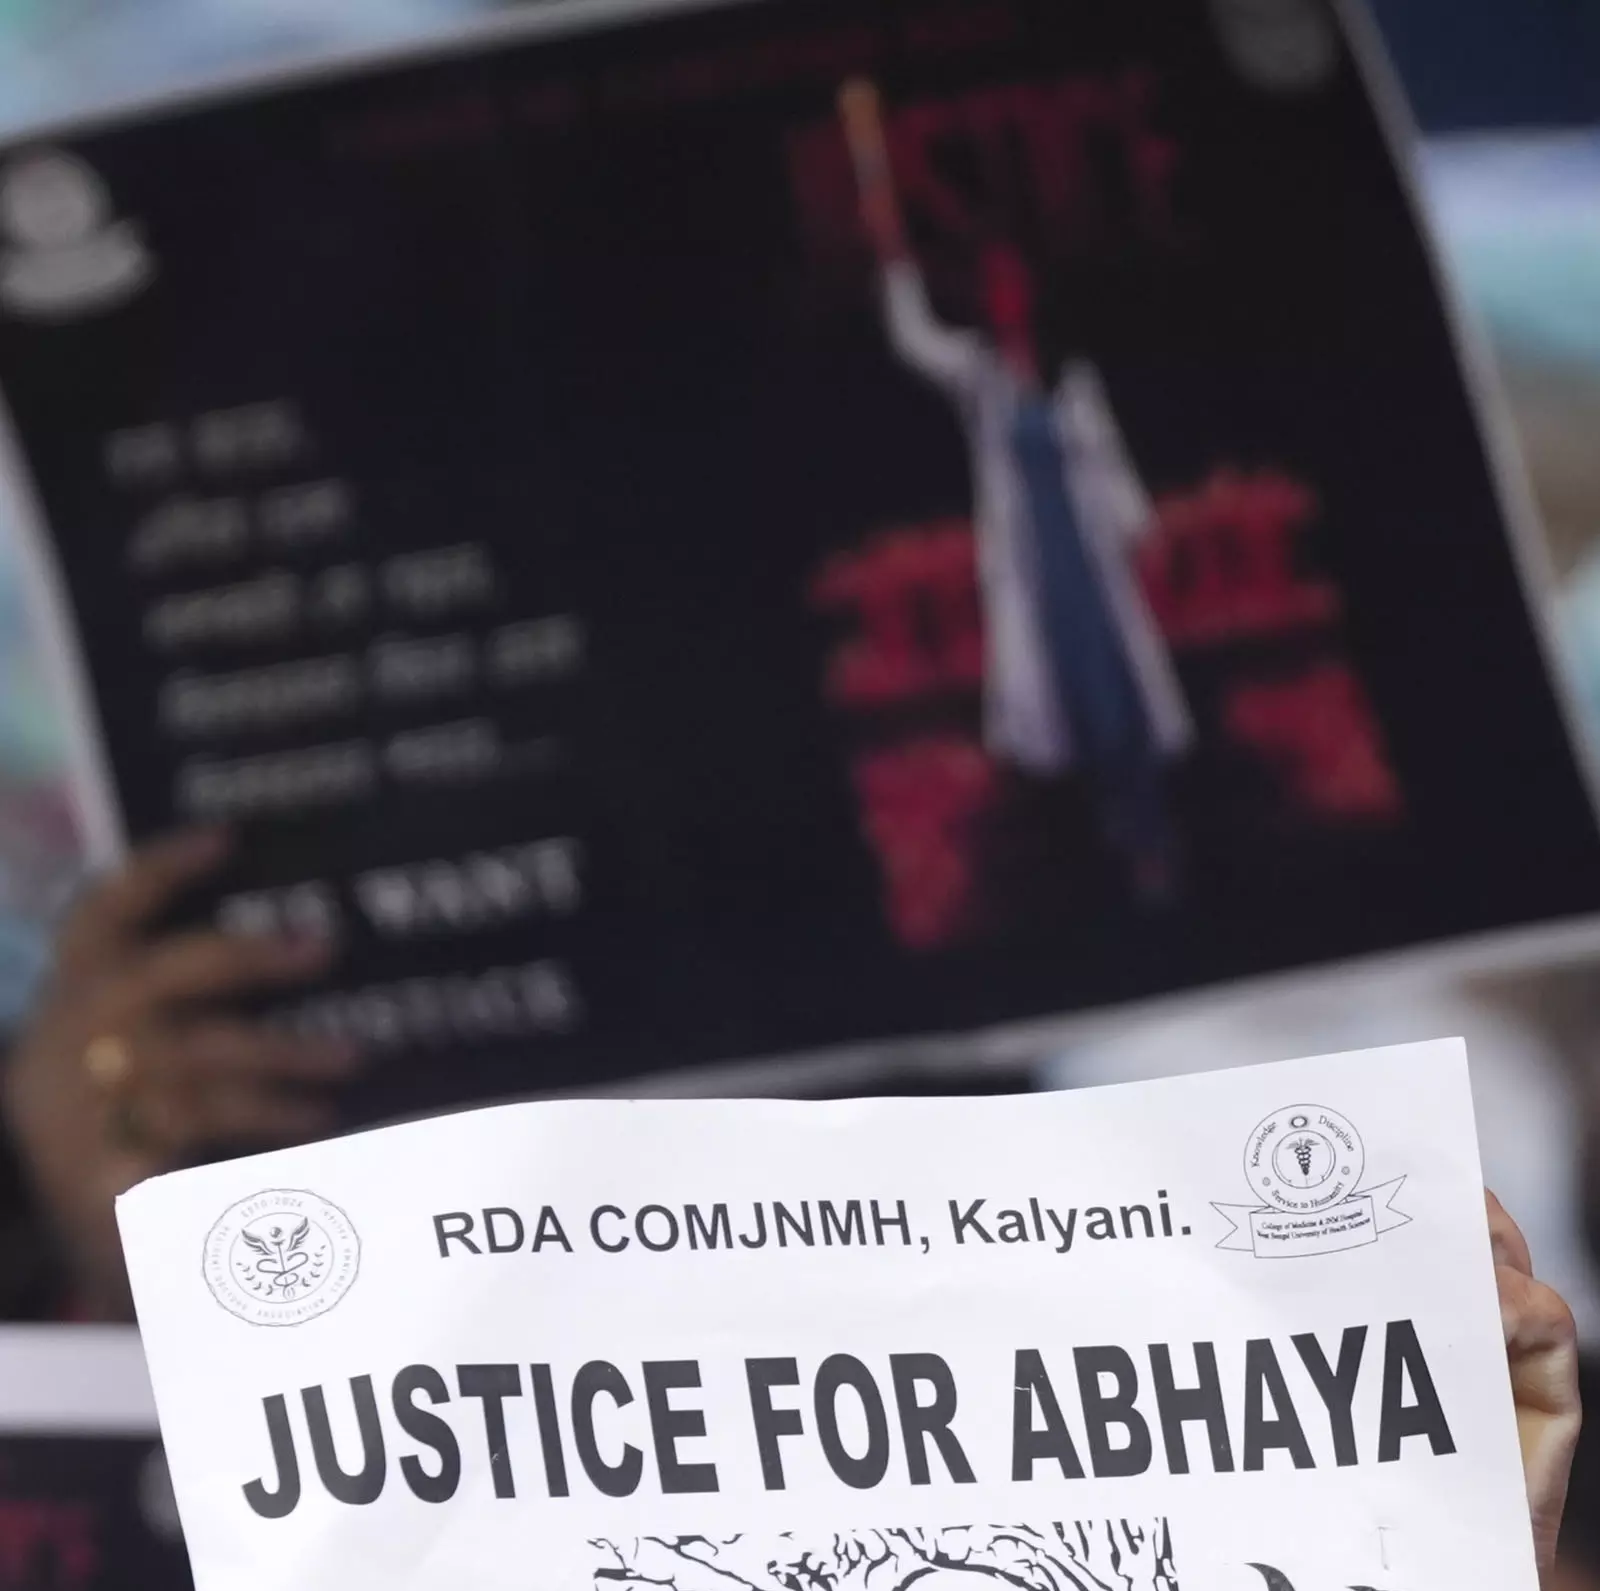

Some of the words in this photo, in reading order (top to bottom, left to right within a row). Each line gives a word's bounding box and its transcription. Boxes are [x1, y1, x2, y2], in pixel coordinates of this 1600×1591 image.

[1318, 1115, 1355, 1152] Discipline
[433, 1206, 574, 1258] RDA
[590, 1199, 930, 1254] COMJNMH,
[948, 1189, 1191, 1254] Kalyani.
[243, 1360, 720, 1519] JUSTICE
[744, 1354, 977, 1491] FOR
[1011, 1320, 1457, 1482] ABHAYA
